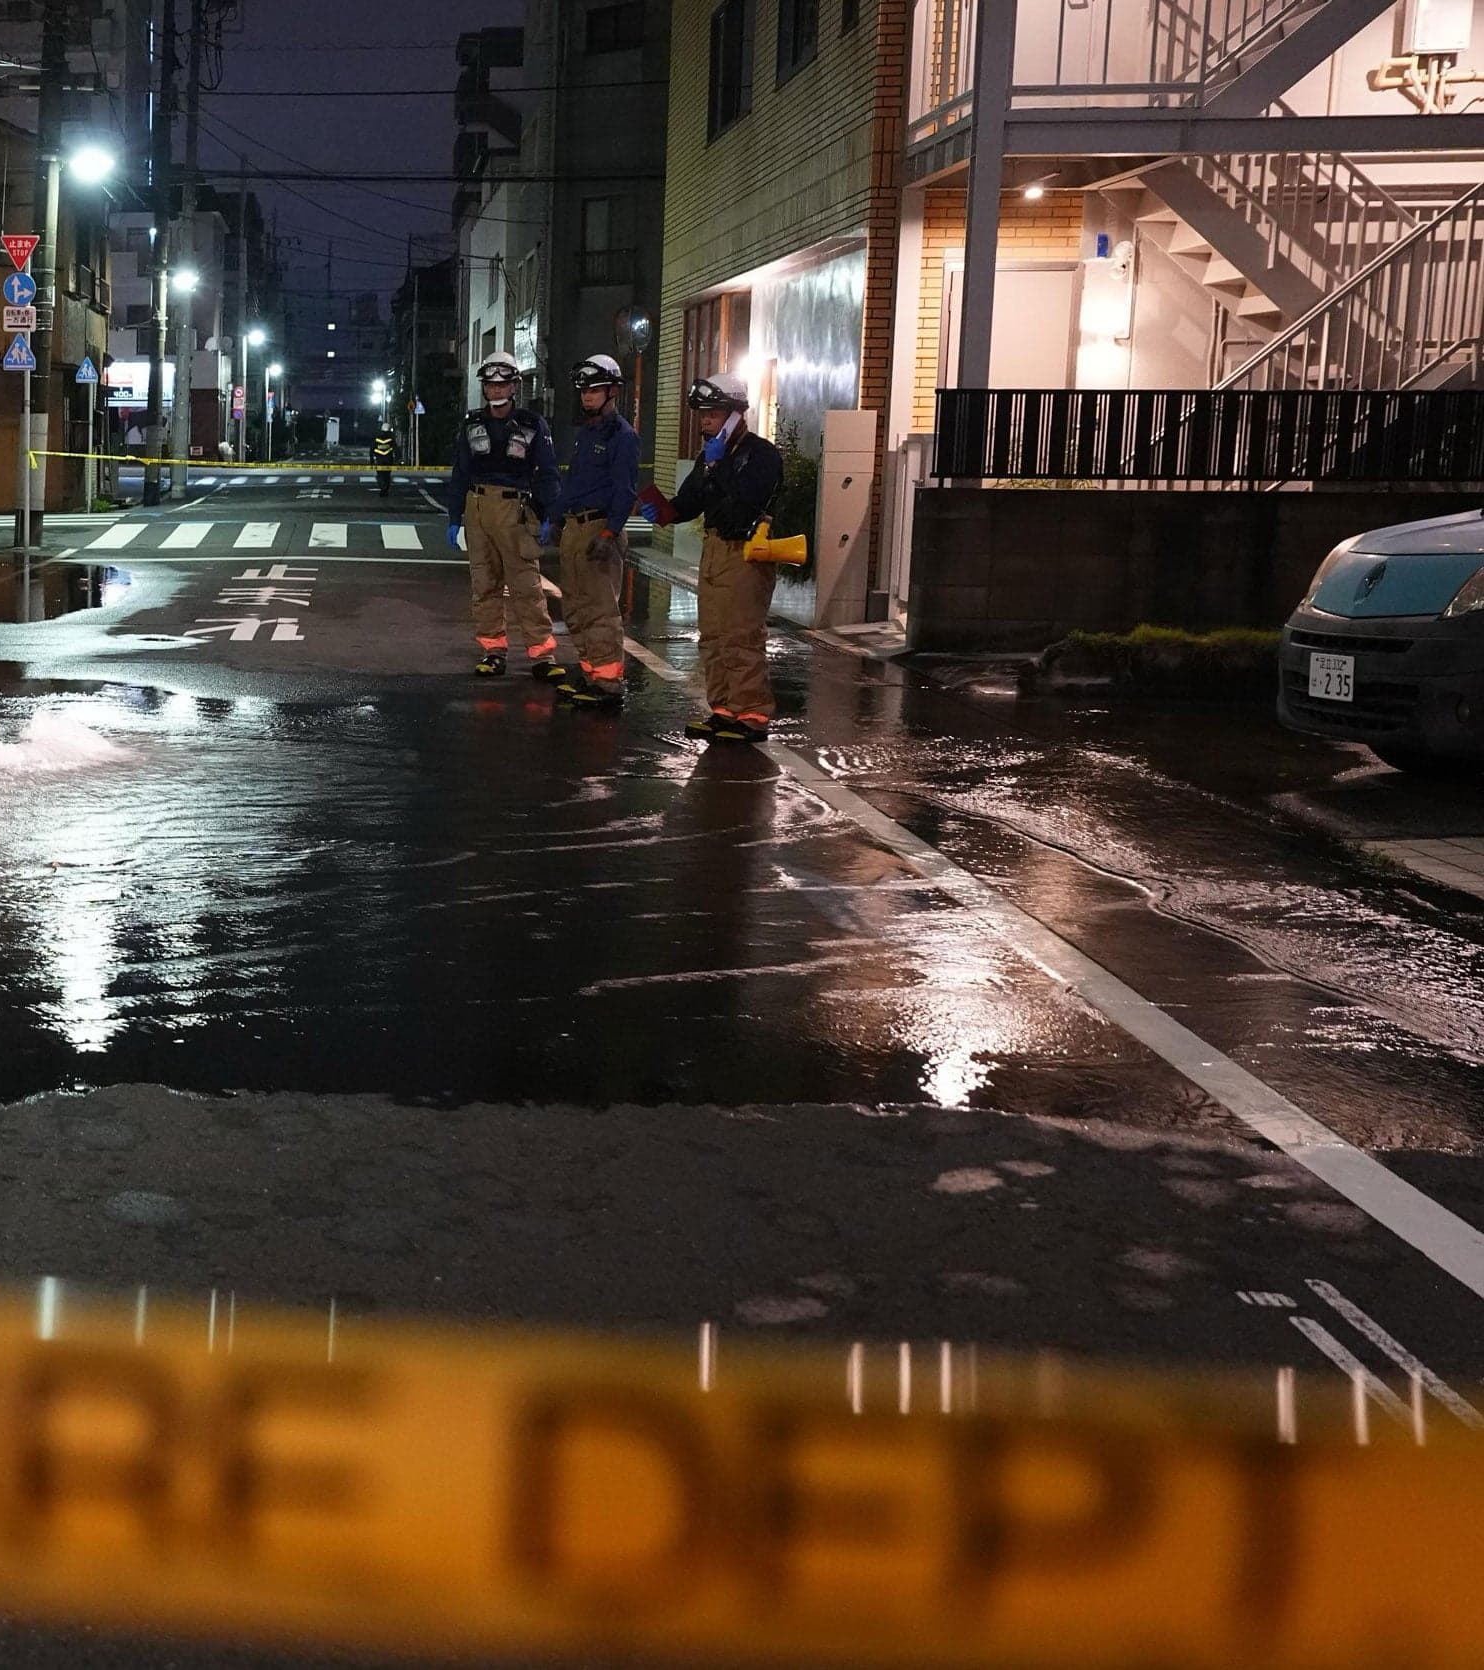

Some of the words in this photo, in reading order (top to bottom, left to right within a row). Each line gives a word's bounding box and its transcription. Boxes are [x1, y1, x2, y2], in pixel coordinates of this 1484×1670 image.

[9, 240, 31, 249] 止まれ
[12, 249, 28, 257] STOP
[183, 564, 319, 641] 止まれ
[501, 1382, 1321, 1652] DEPT
